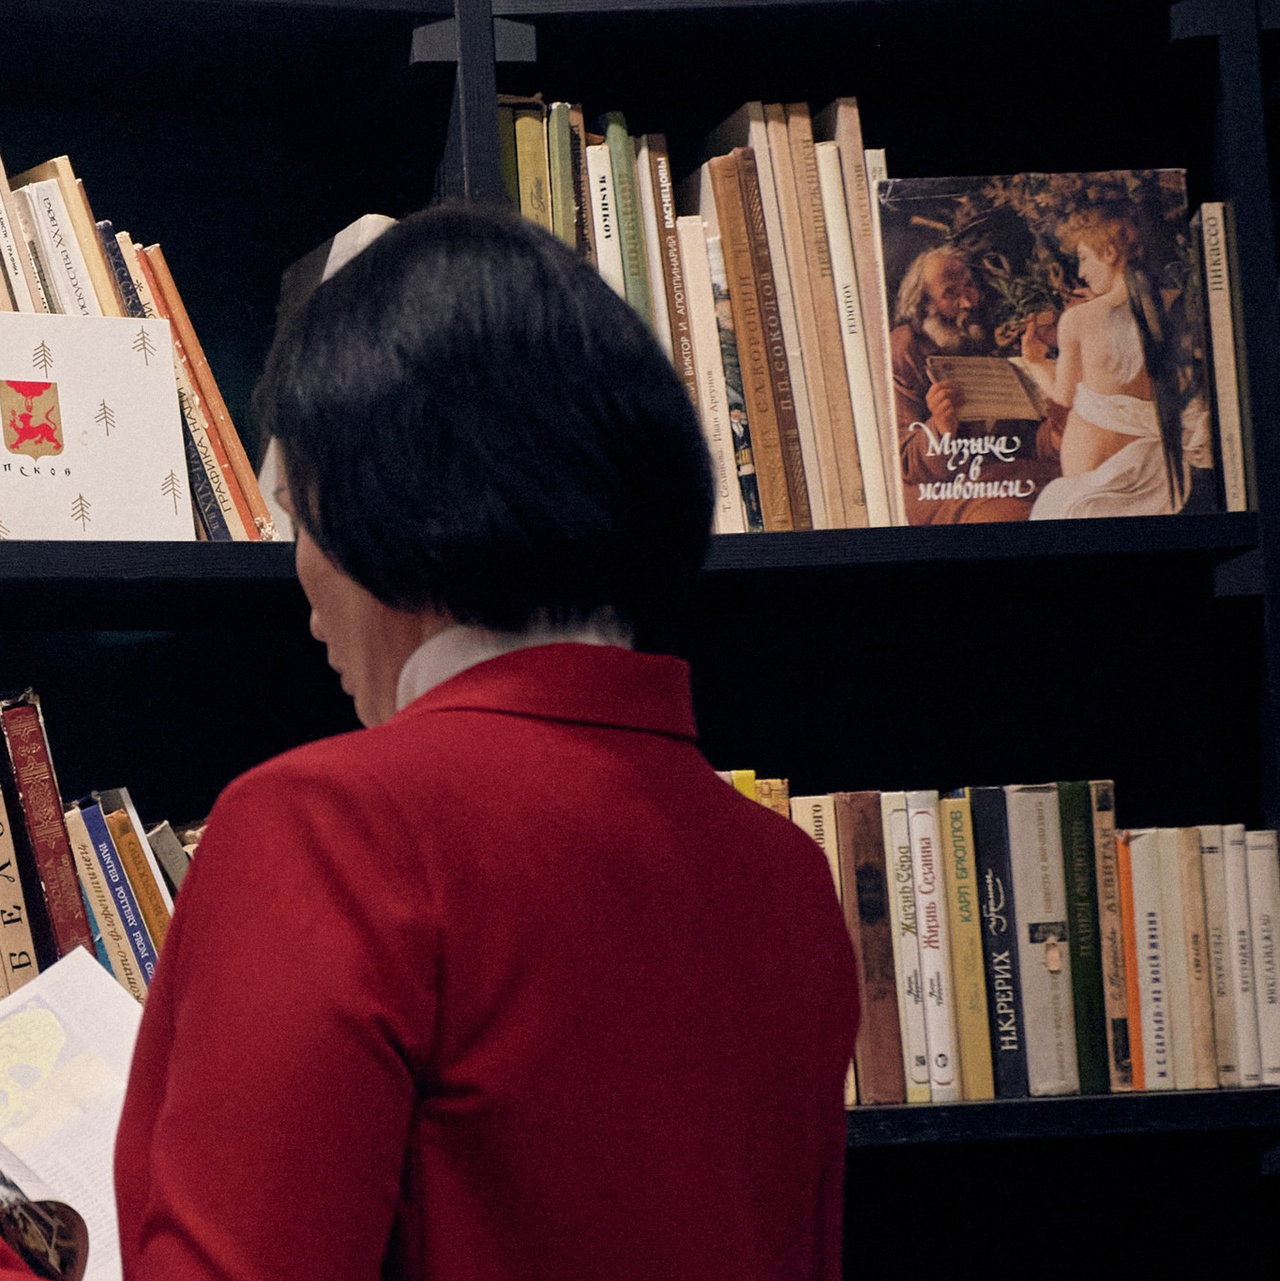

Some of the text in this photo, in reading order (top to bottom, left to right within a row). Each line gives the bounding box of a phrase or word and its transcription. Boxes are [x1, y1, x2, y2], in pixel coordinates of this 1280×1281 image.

[6, 245, 19, 276] ГРАФИКА
[657, 157, 686, 315] АПОЛЛИНАРИЙ ВАСНЕЦОВЫ
[1206, 216, 1223, 291] ПИКАССО
[761, 271, 785, 371] СОКОЛОВ
[842, 283, 857, 335] FEDOTOV
[705, 370, 720, 442] Иван Аргунов
[197, 436, 232, 513] ГРАФИКА
[908, 422, 1021, 471] Музыка
[969, 455, 983, 480] в
[918, 473, 1035, 501] живописи
[917, 837, 934, 895] Сезанна
[950, 810, 966, 879] БРЮЛЛОВ
[1100, 827, 1117, 914] ЛЕВИТАН
[100, 843, 136, 926] PAINTED POTTERY
[1147, 912, 1158, 949] ЖИЗНИ
[1261, 914, 1276, 1004] МИКЕЛАНДЖЕЛО
[1147, 955, 1161, 983] МОЕЙ
